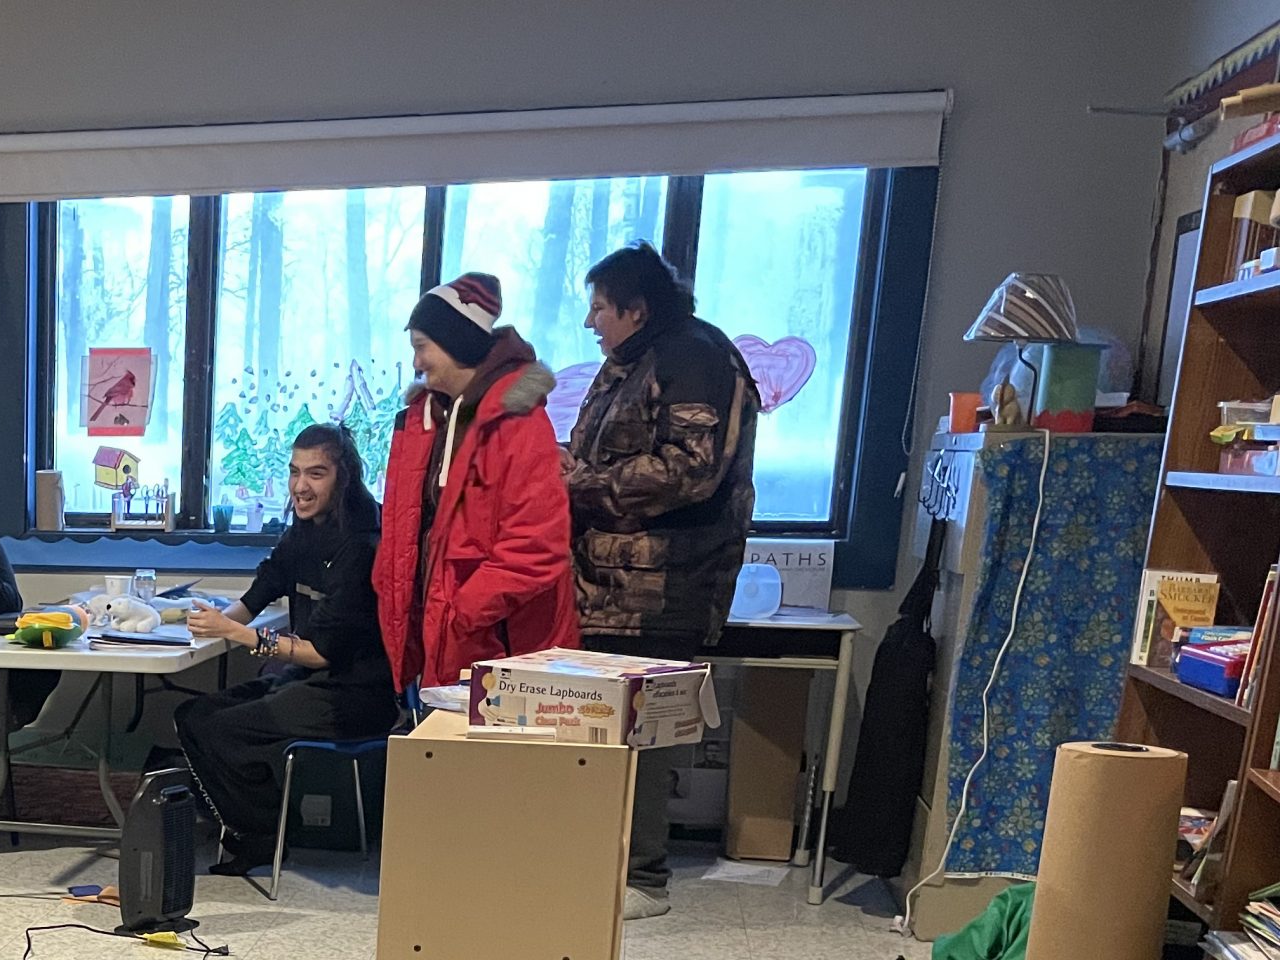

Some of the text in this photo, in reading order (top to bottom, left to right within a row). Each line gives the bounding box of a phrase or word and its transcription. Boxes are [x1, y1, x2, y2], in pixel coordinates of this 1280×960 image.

[750, 552, 828, 567] PATHS
[498, 680, 603, 701] Dry Erase Lapboards
